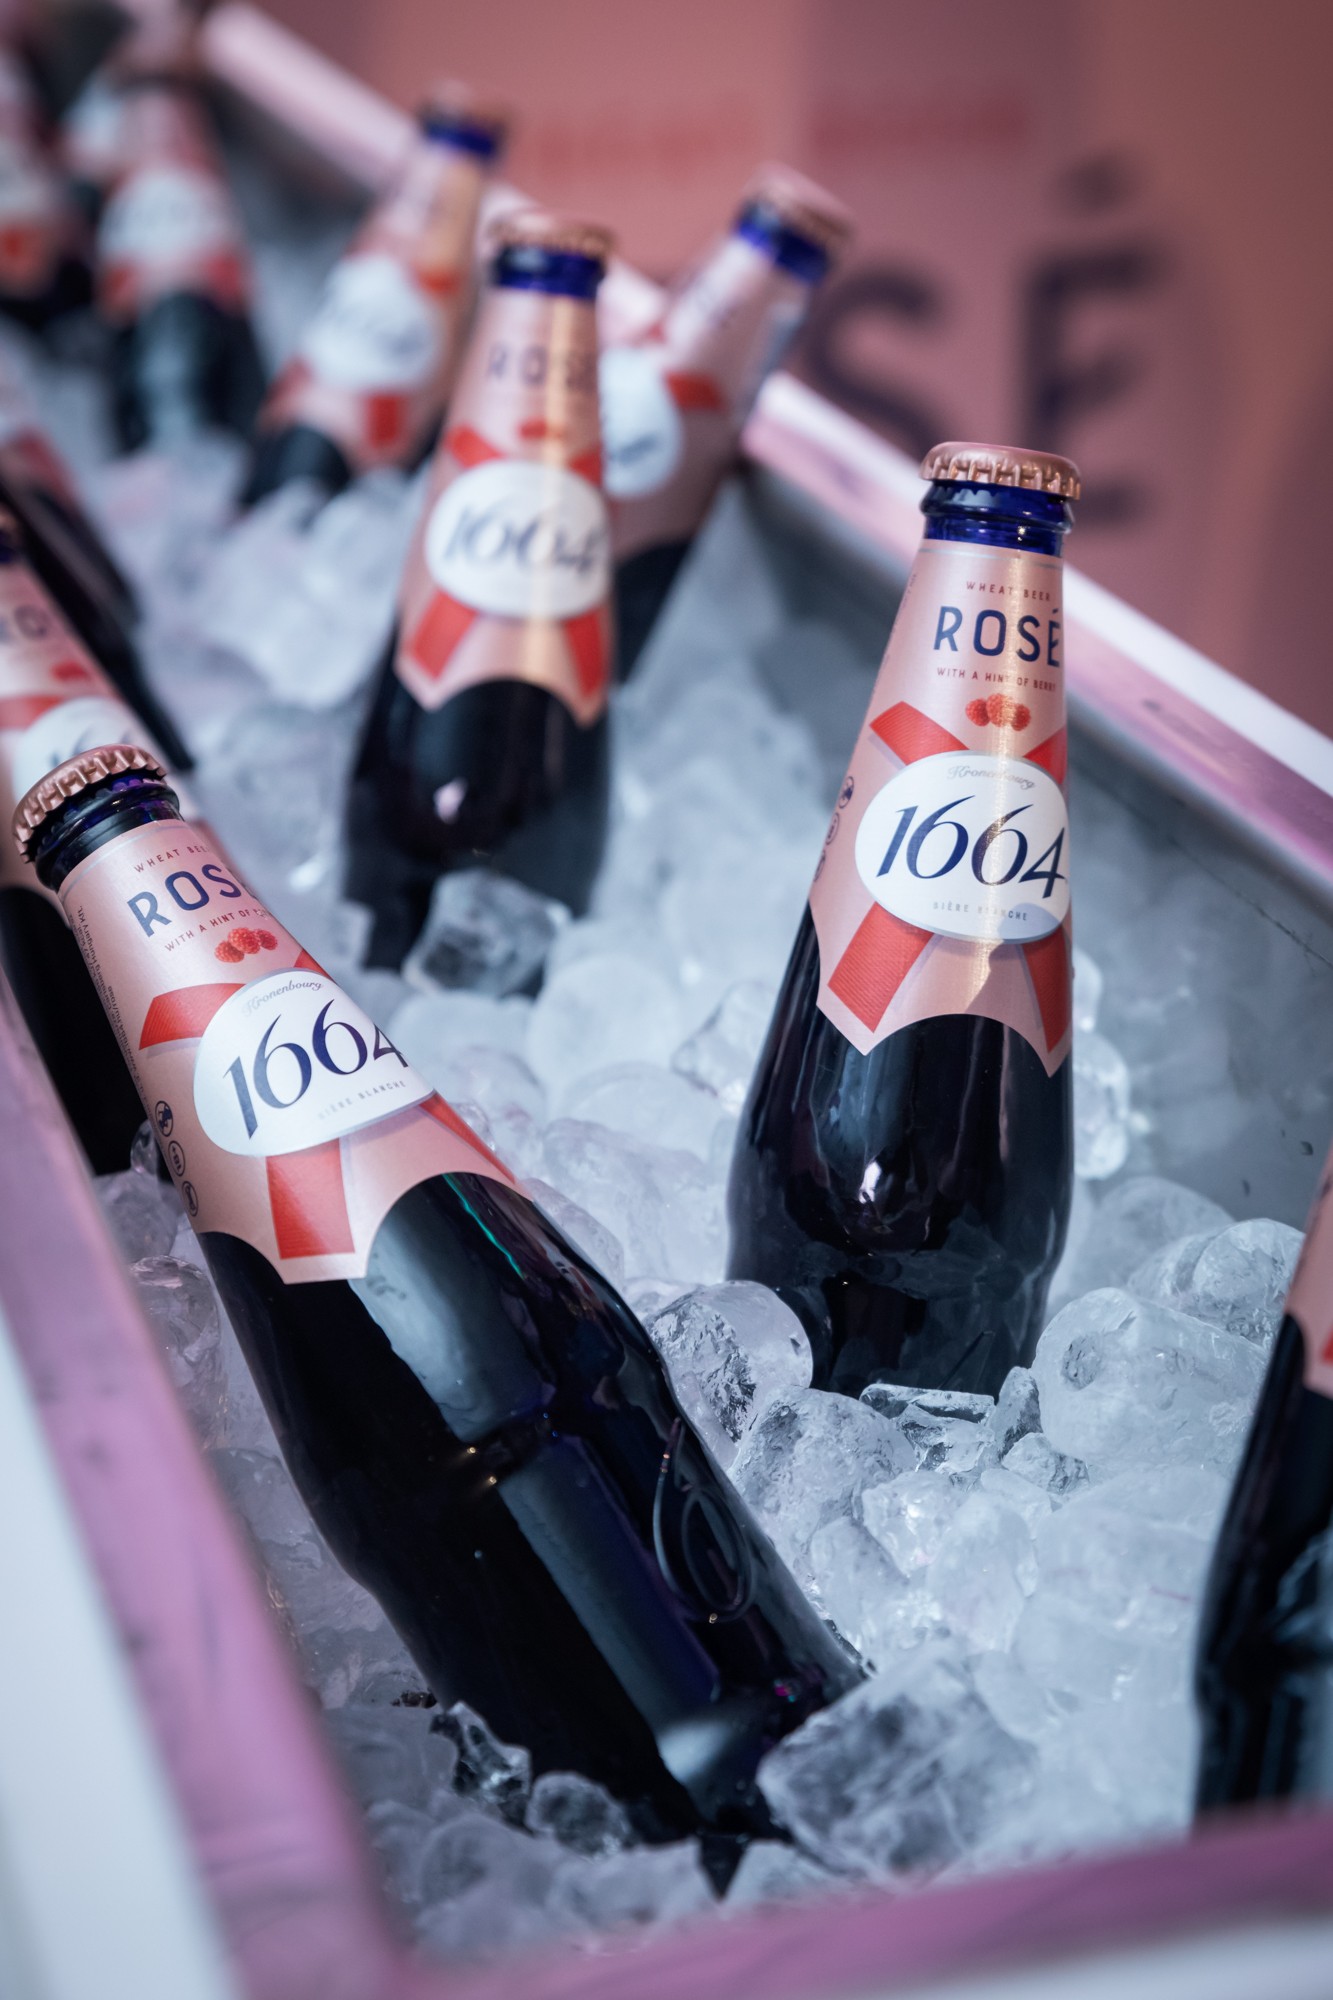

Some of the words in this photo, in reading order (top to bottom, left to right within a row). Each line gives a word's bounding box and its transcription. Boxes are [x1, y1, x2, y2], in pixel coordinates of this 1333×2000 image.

[966, 581, 1013, 596] WHEAT
[1024, 589, 1050, 601] BEER
[933, 605, 1060, 668] ROSÉ
[937, 667, 965, 678] WITH
[971, 671, 979, 680] A
[985, 672, 1010, 683] HINT
[1016, 677, 1028, 686] OF
[947, 766, 1035, 790] Kroneourg
[134, 849, 180, 873] WHEAT
[186, 845, 210, 853] BEE
[876, 795, 1068, 898] 1664
[127, 864, 242, 938] ROS
[933, 900, 969, 912] BIÈRE
[164, 930, 194, 951] WITH
[199, 924, 207, 933] A
[210, 913, 235, 927] HINT
[238, 909, 250, 917] OF
[242, 979, 322, 1020] Kronenbourg
[223, 999, 409, 1140] 1664
[358, 1080, 406, 1099] BLANCHE
